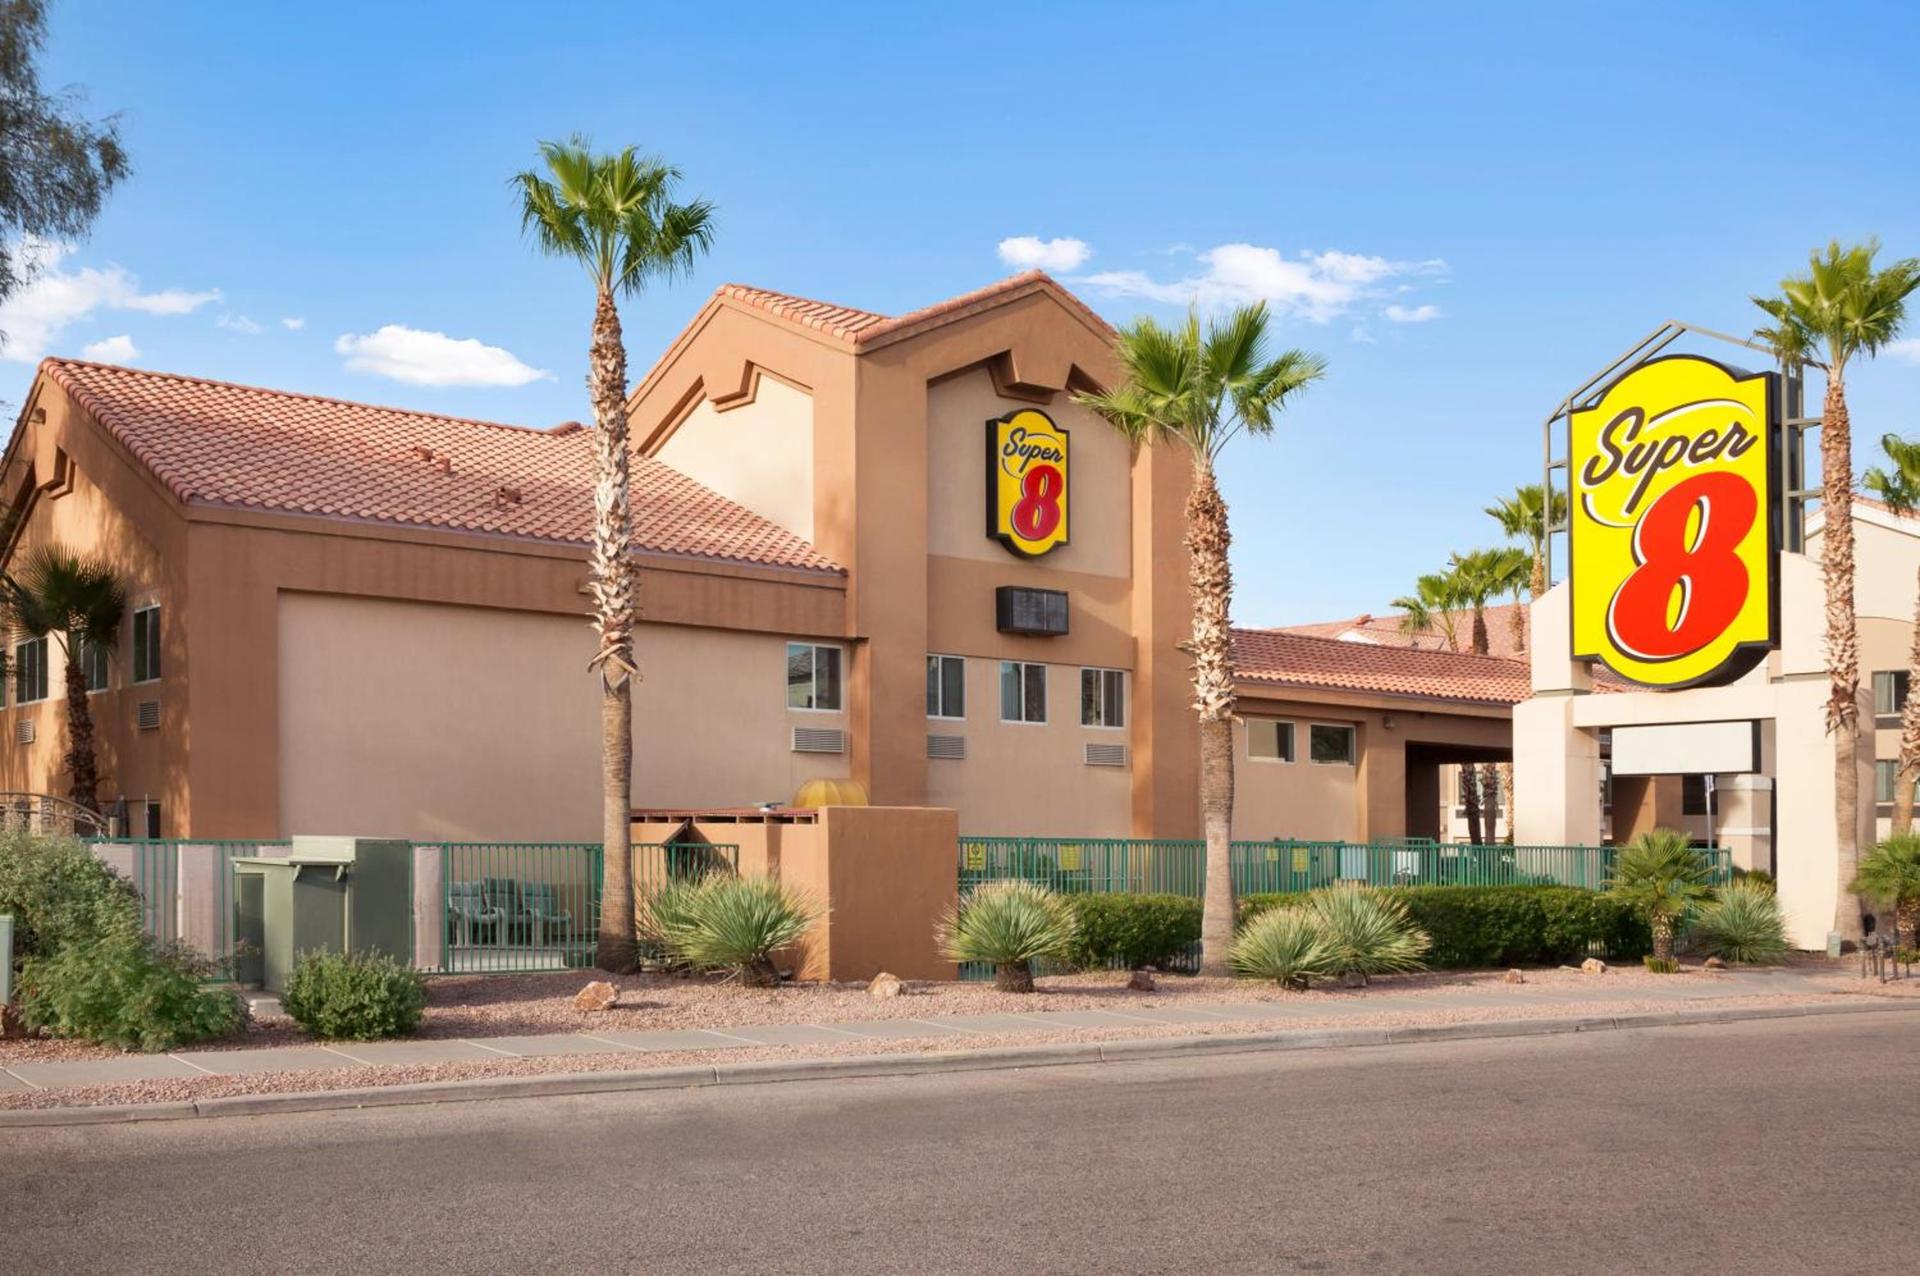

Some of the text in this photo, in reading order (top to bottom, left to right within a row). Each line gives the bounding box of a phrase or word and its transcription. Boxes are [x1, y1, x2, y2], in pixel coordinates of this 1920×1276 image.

[1002, 427, 1063, 473] Super
[1582, 406, 1759, 515] Super
[1011, 464, 1063, 541] 8
[1605, 471, 1758, 663] 8
